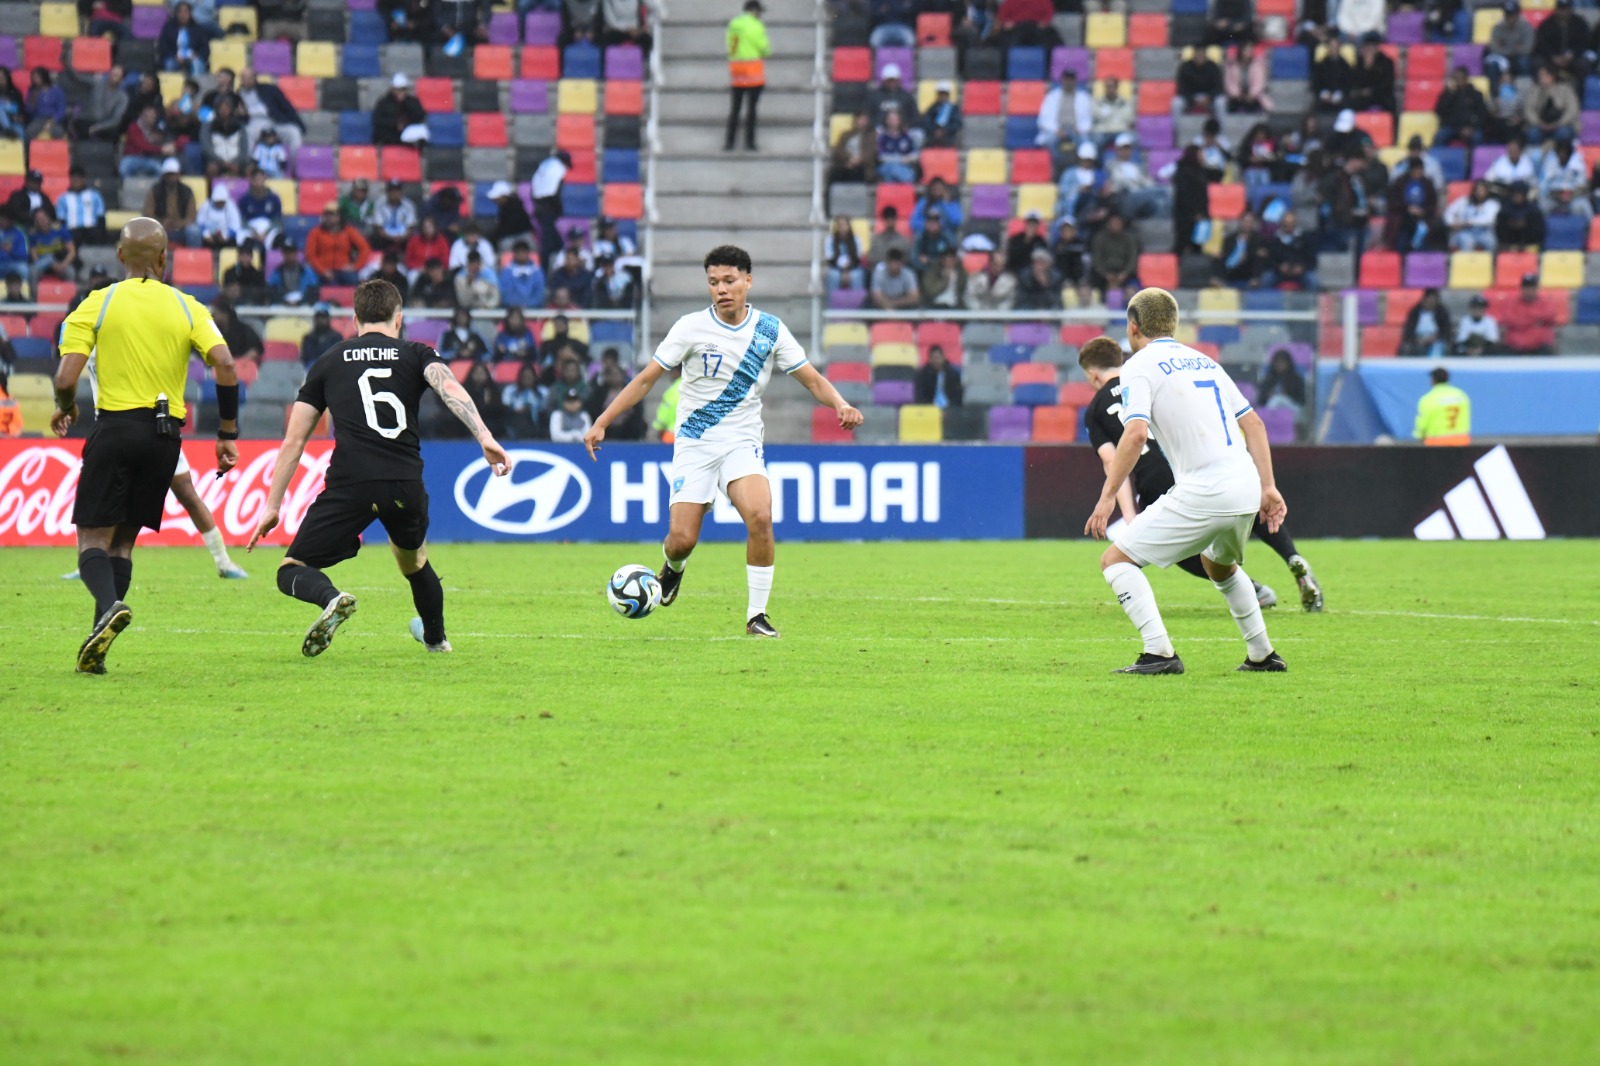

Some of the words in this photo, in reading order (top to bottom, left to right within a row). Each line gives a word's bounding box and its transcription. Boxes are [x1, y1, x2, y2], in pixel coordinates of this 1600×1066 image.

[343, 347, 399, 362] CONCHIE
[702, 353, 722, 377] 17
[358, 368, 407, 439] 6
[1193, 379, 1233, 446] 7
[610, 461, 941, 524] HNDAI
